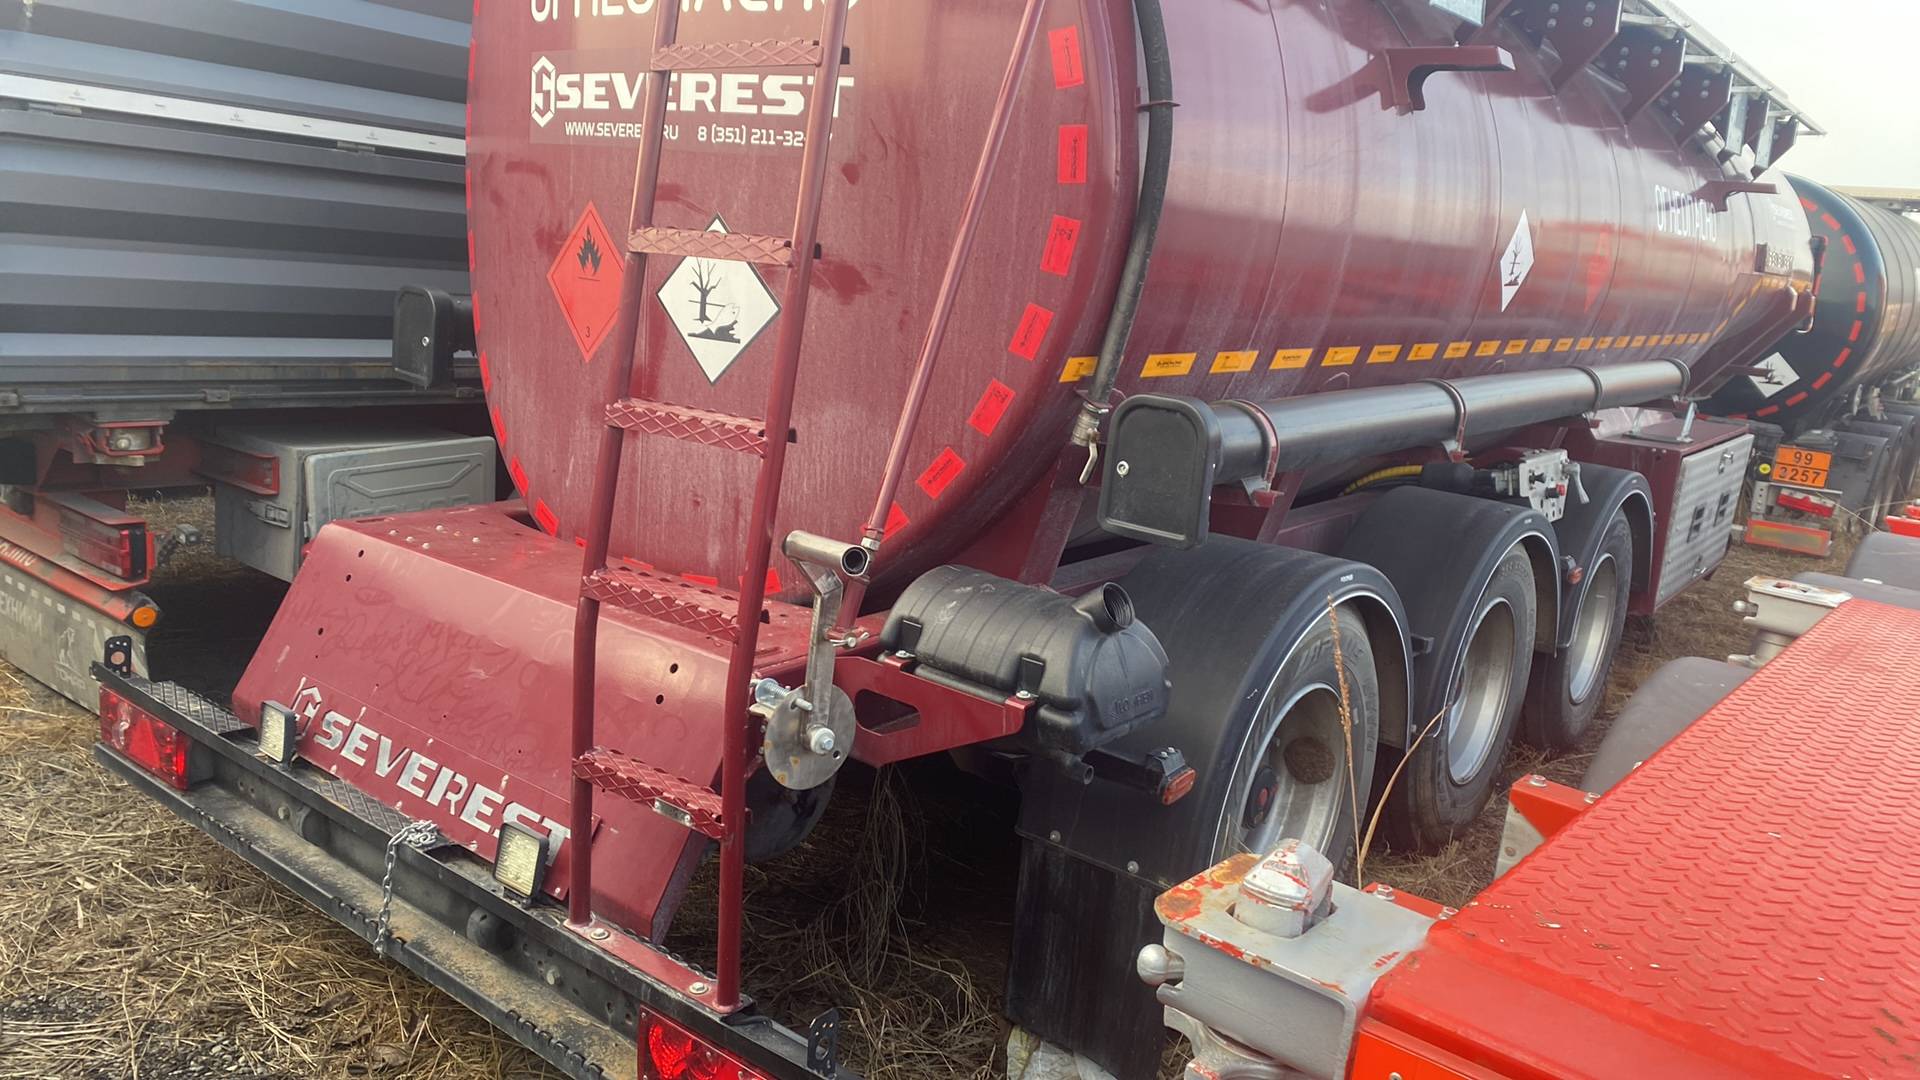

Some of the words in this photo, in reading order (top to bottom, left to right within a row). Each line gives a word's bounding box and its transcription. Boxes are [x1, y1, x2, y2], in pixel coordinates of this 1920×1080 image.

[697, 126, 707, 142] 8
[711, 123, 746, 145] (351)
[585, 326, 591, 338] 3
[1794, 451, 1813, 465] 99
